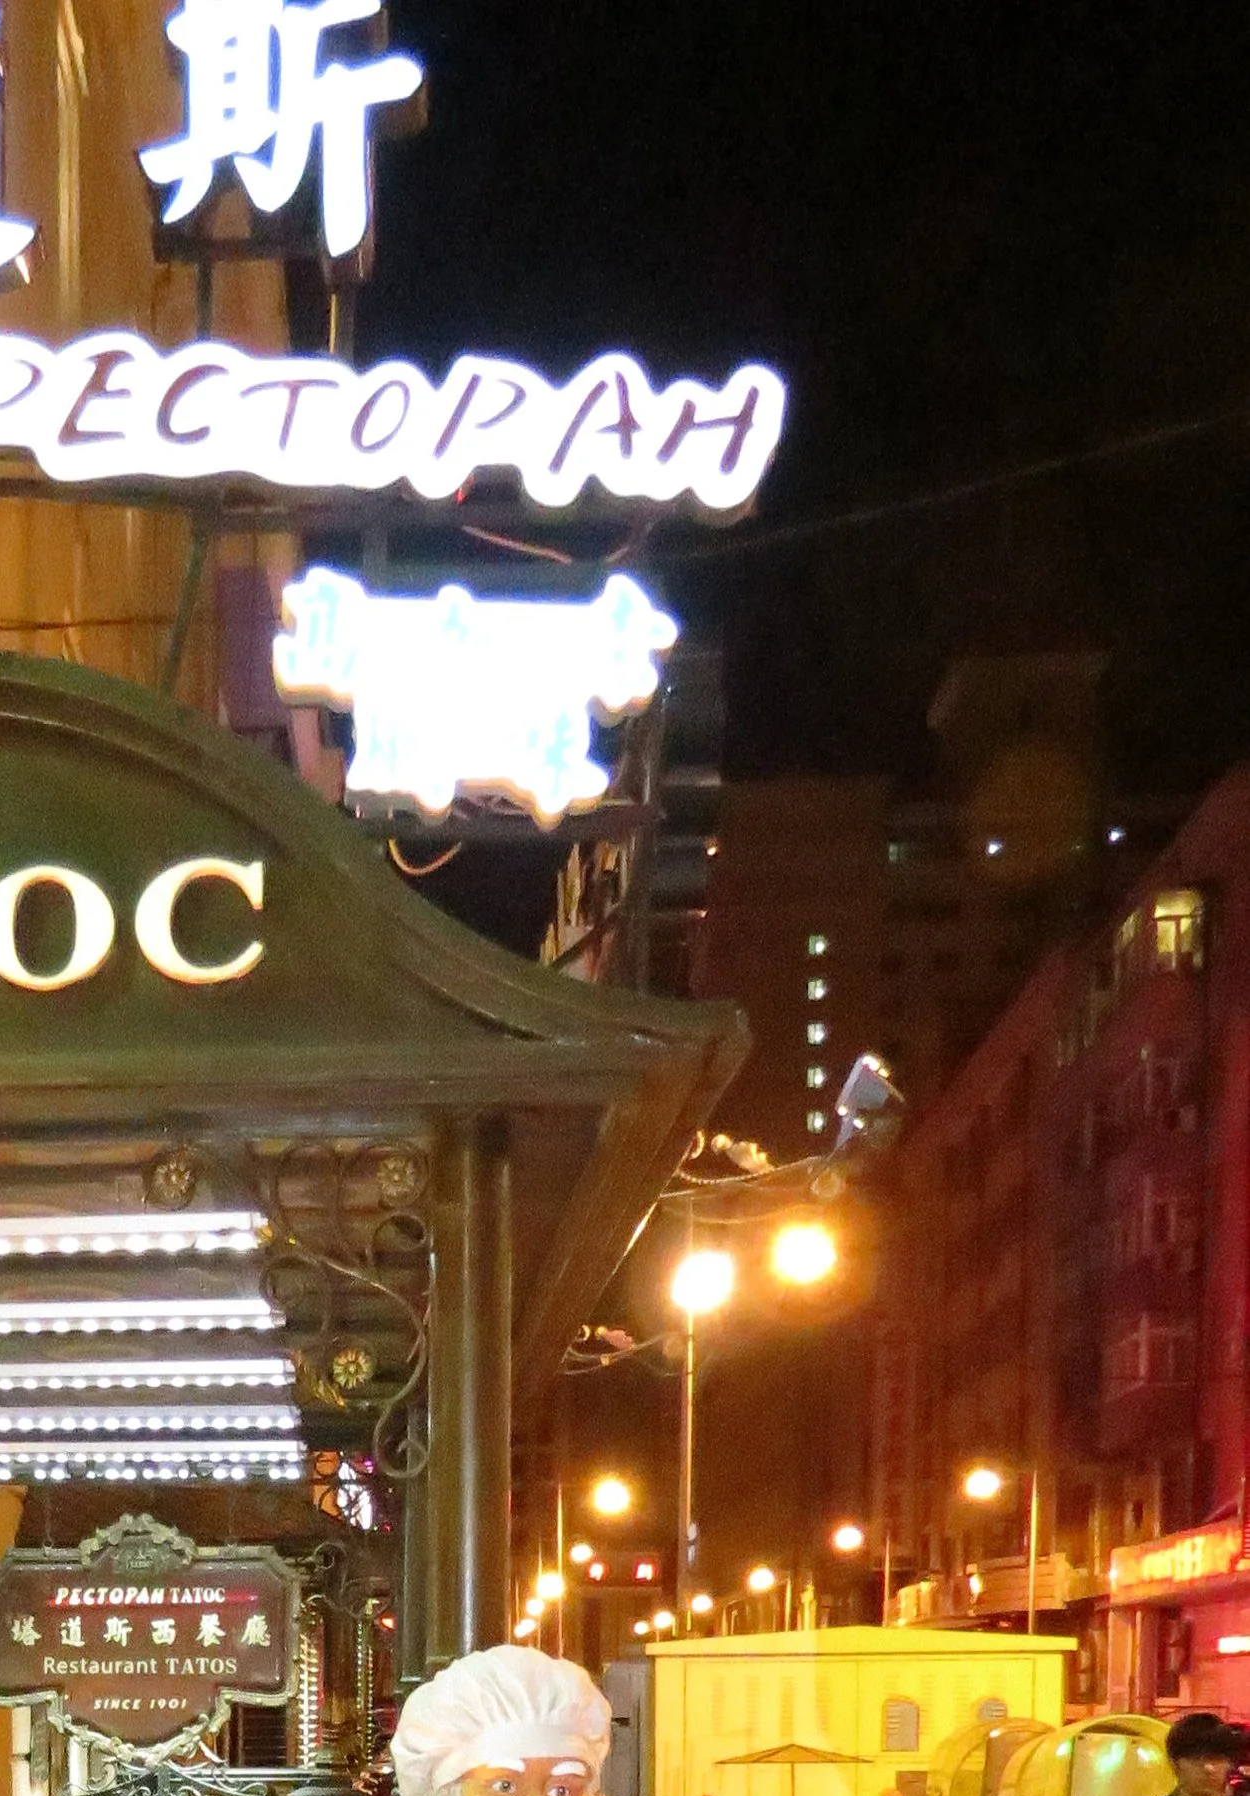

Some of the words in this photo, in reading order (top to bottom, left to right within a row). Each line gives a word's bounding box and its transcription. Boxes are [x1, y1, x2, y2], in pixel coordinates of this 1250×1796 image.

[43, 1656, 158, 1675] Restaurant
[165, 1657, 237, 1675] TATOS
[94, 1698, 141, 1710] SINCE
[150, 1698, 188, 1711] 1901
